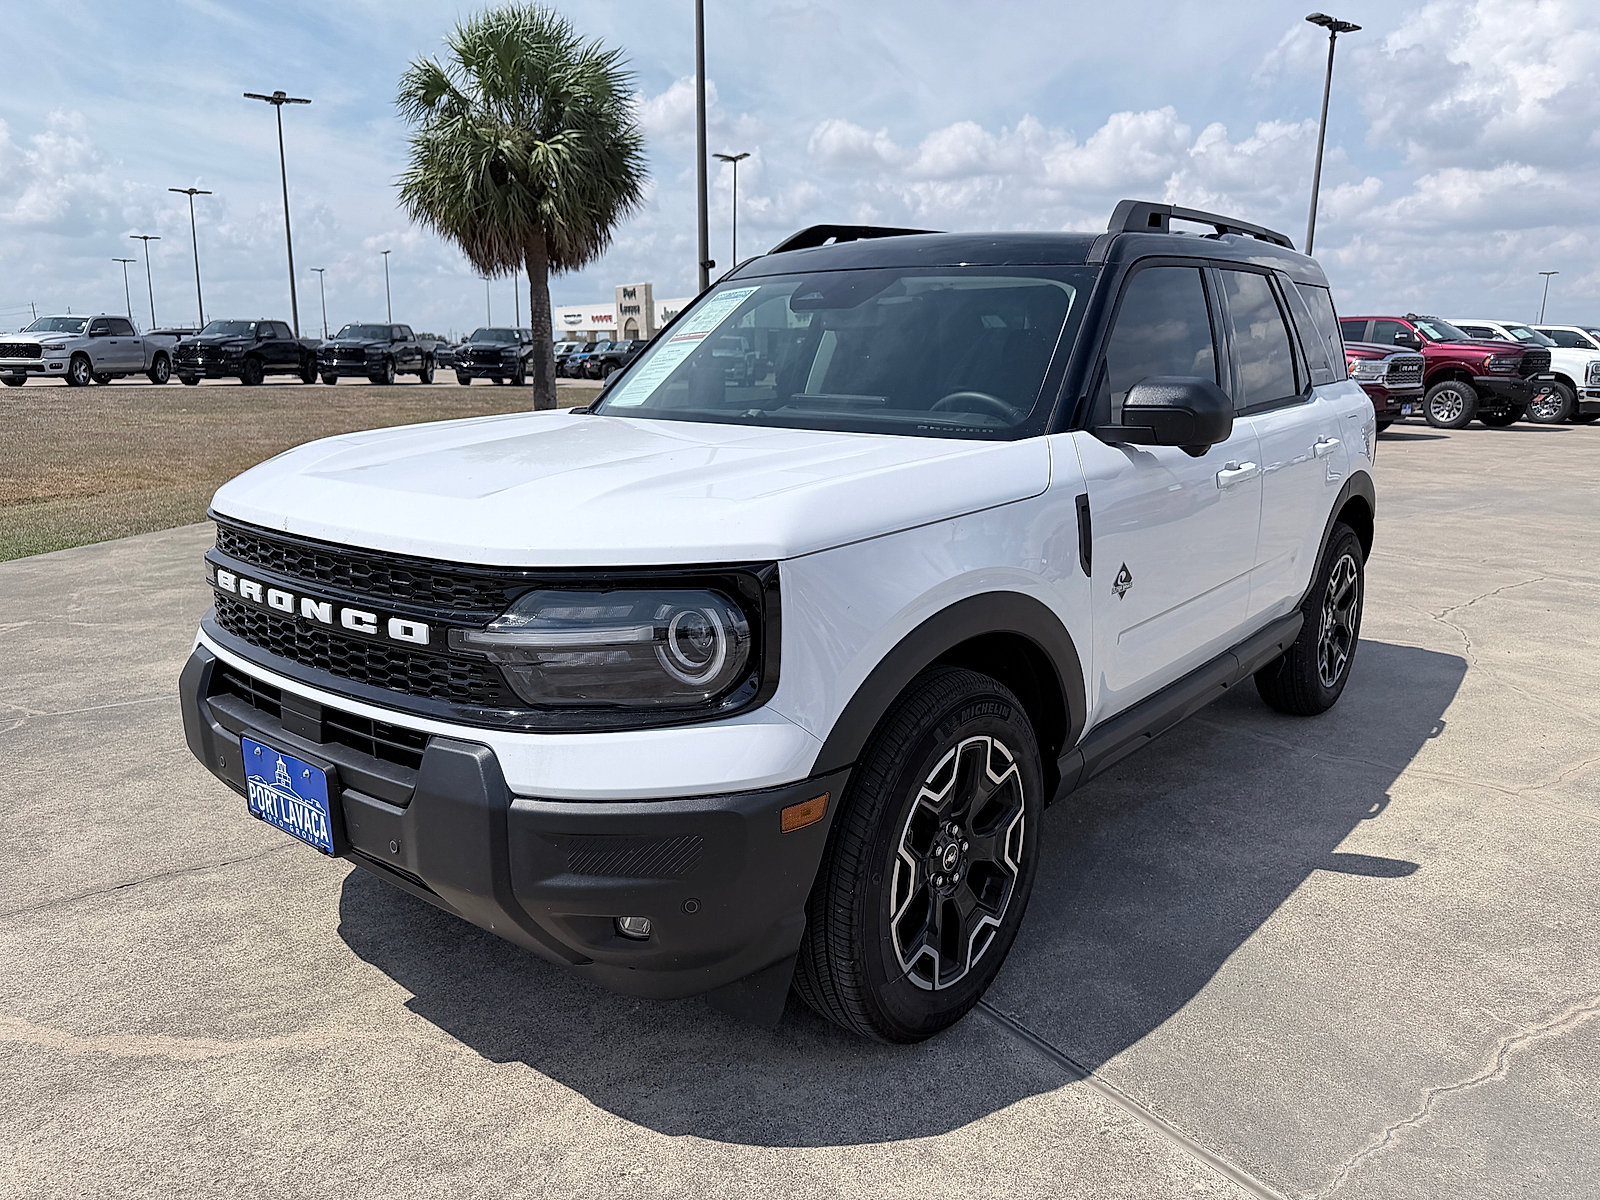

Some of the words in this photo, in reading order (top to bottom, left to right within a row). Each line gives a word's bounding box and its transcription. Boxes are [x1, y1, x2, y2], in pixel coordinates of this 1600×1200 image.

[217, 569, 430, 645] BRONCO
[961, 702, 1010, 723] MICHELIN
[249, 782, 279, 818] PORT
[280, 796, 330, 844] LAVACA
[262, 811, 284, 828] AUTO
[289, 825, 319, 844] GROUP
